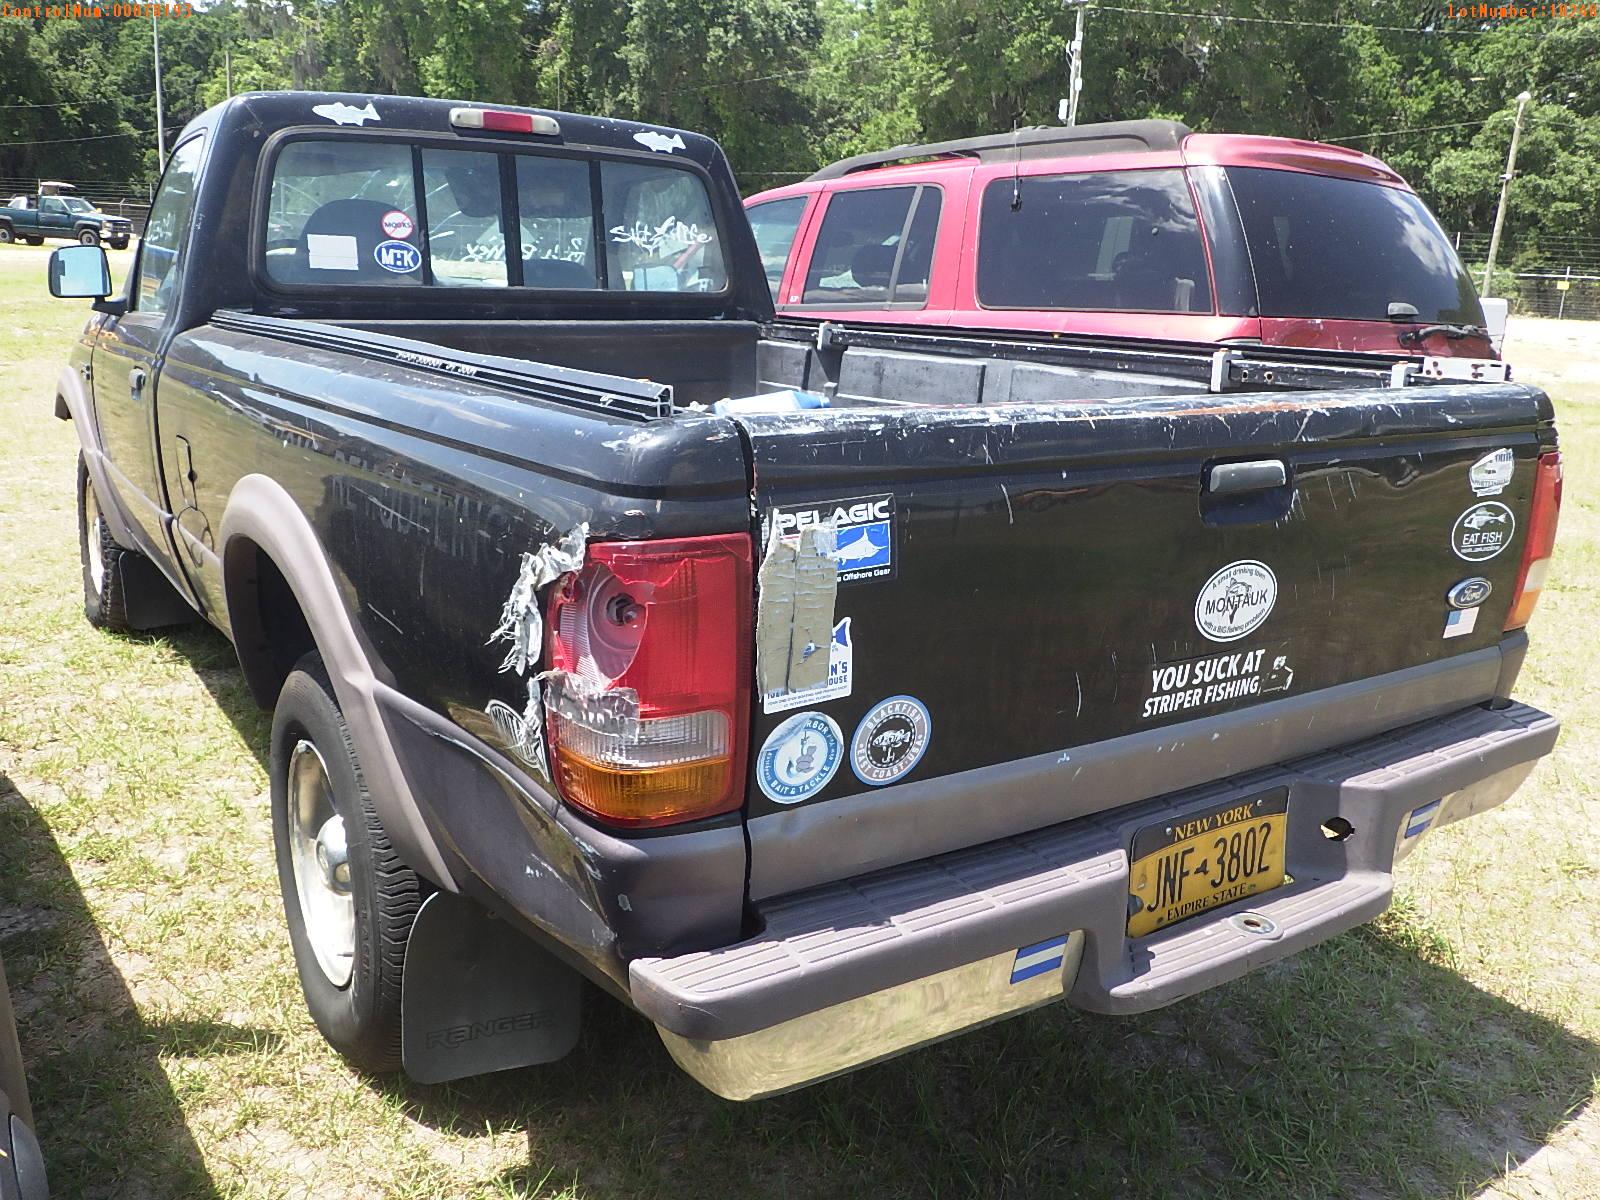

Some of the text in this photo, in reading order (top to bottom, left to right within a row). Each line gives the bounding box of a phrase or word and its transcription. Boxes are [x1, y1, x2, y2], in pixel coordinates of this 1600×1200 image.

[776, 500, 890, 534] PELAGIC
[1463, 531, 1502, 545] EAT FISH
[843, 571, 873, 582] Offshore
[873, 569, 891, 577] Gear
[1205, 588, 1268, 615] MONTAUK
[1461, 585, 1484, 603] Ford
[1152, 649, 1266, 693] YOU SUCK AT
[1142, 675, 1260, 718] STRIPER FISHING
[867, 703, 922, 730] BLACKFISH
[857, 740, 924, 779] EAST COAST USA
[770, 766, 831, 796] BAIT & TACKLE
[1174, 803, 1254, 842] NEW YORK
[1167, 882, 1247, 921] EMPIRE STATE
